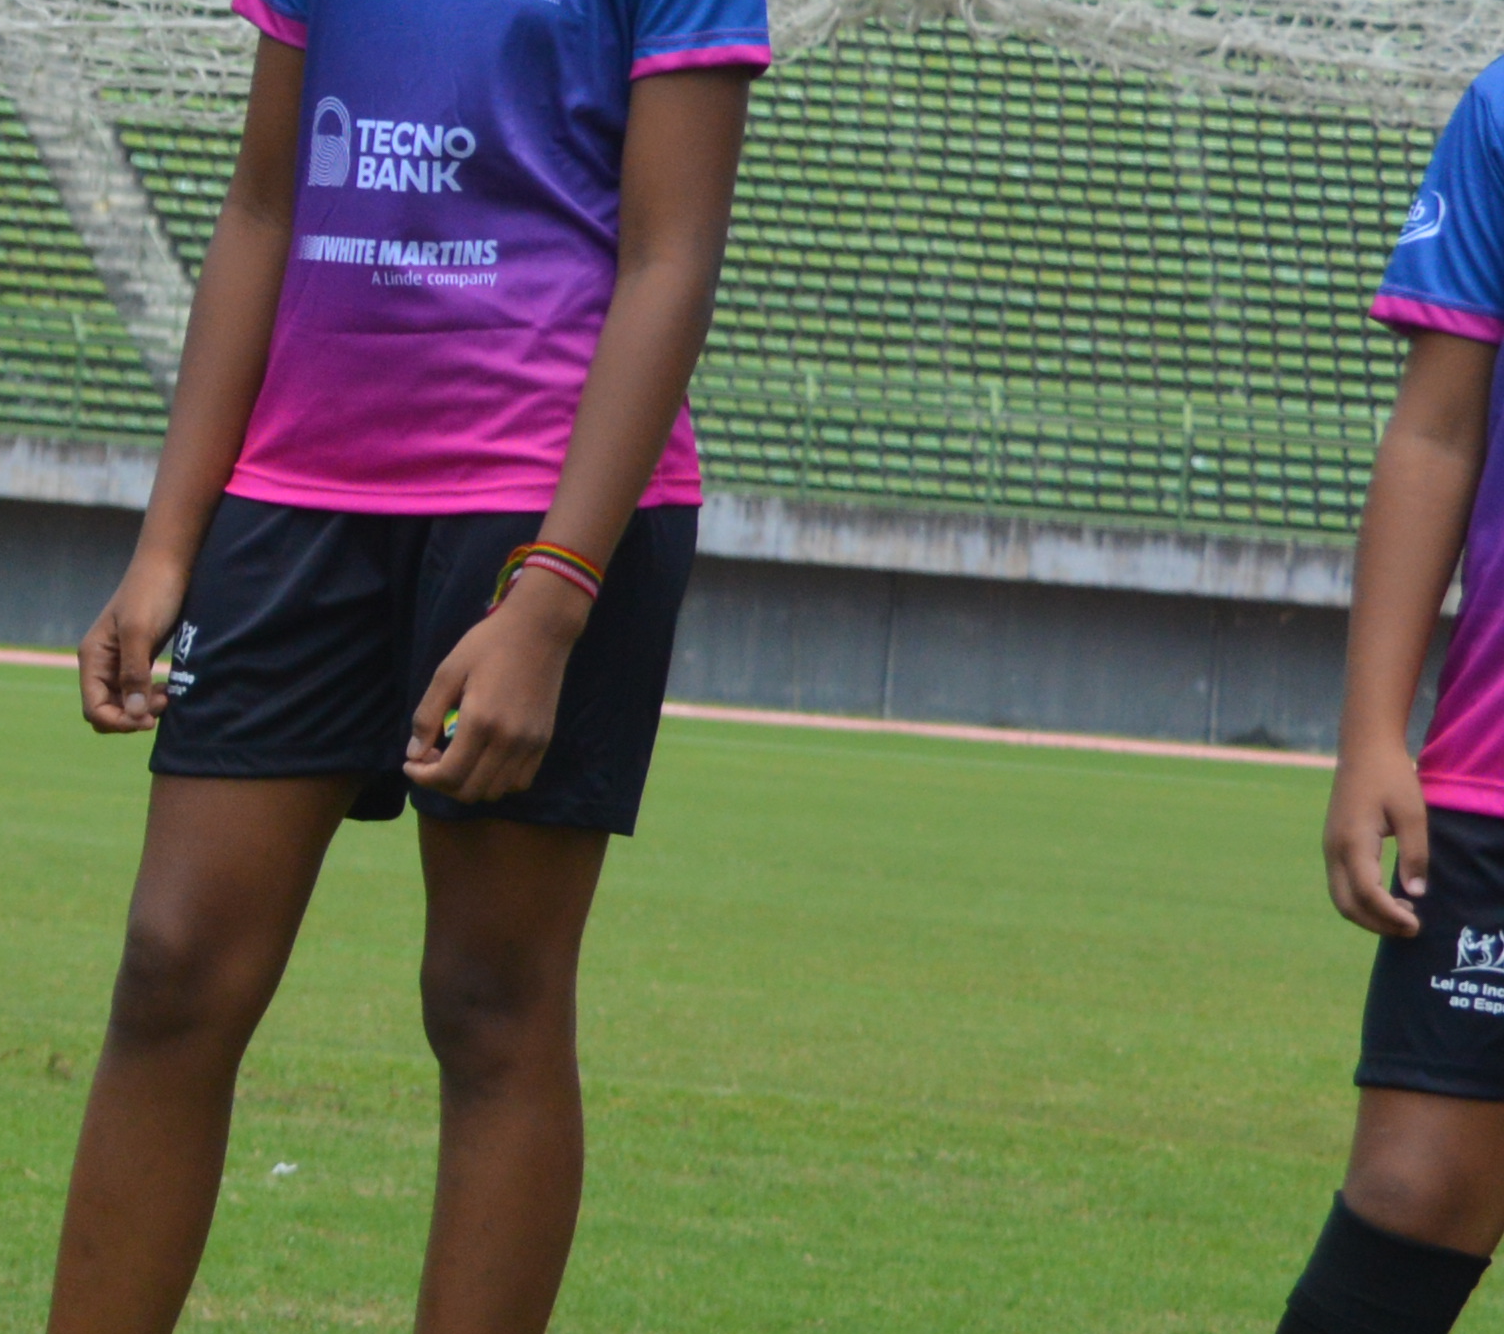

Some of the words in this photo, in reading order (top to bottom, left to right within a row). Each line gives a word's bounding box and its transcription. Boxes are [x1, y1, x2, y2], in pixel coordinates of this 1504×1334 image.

[356, 119, 476, 159] TECNO
[356, 155, 463, 193] BANK
[323, 236, 376, 265] WHITE
[377, 239, 498, 266] MARTINS
[371, 270, 381, 285] A
[384, 270, 423, 285] Linde
[426, 271, 498, 288] company
[1431, 975, 1455, 992] Lei
[1458, 980, 1479, 995] de
[1449, 995, 1470, 1008] ao
